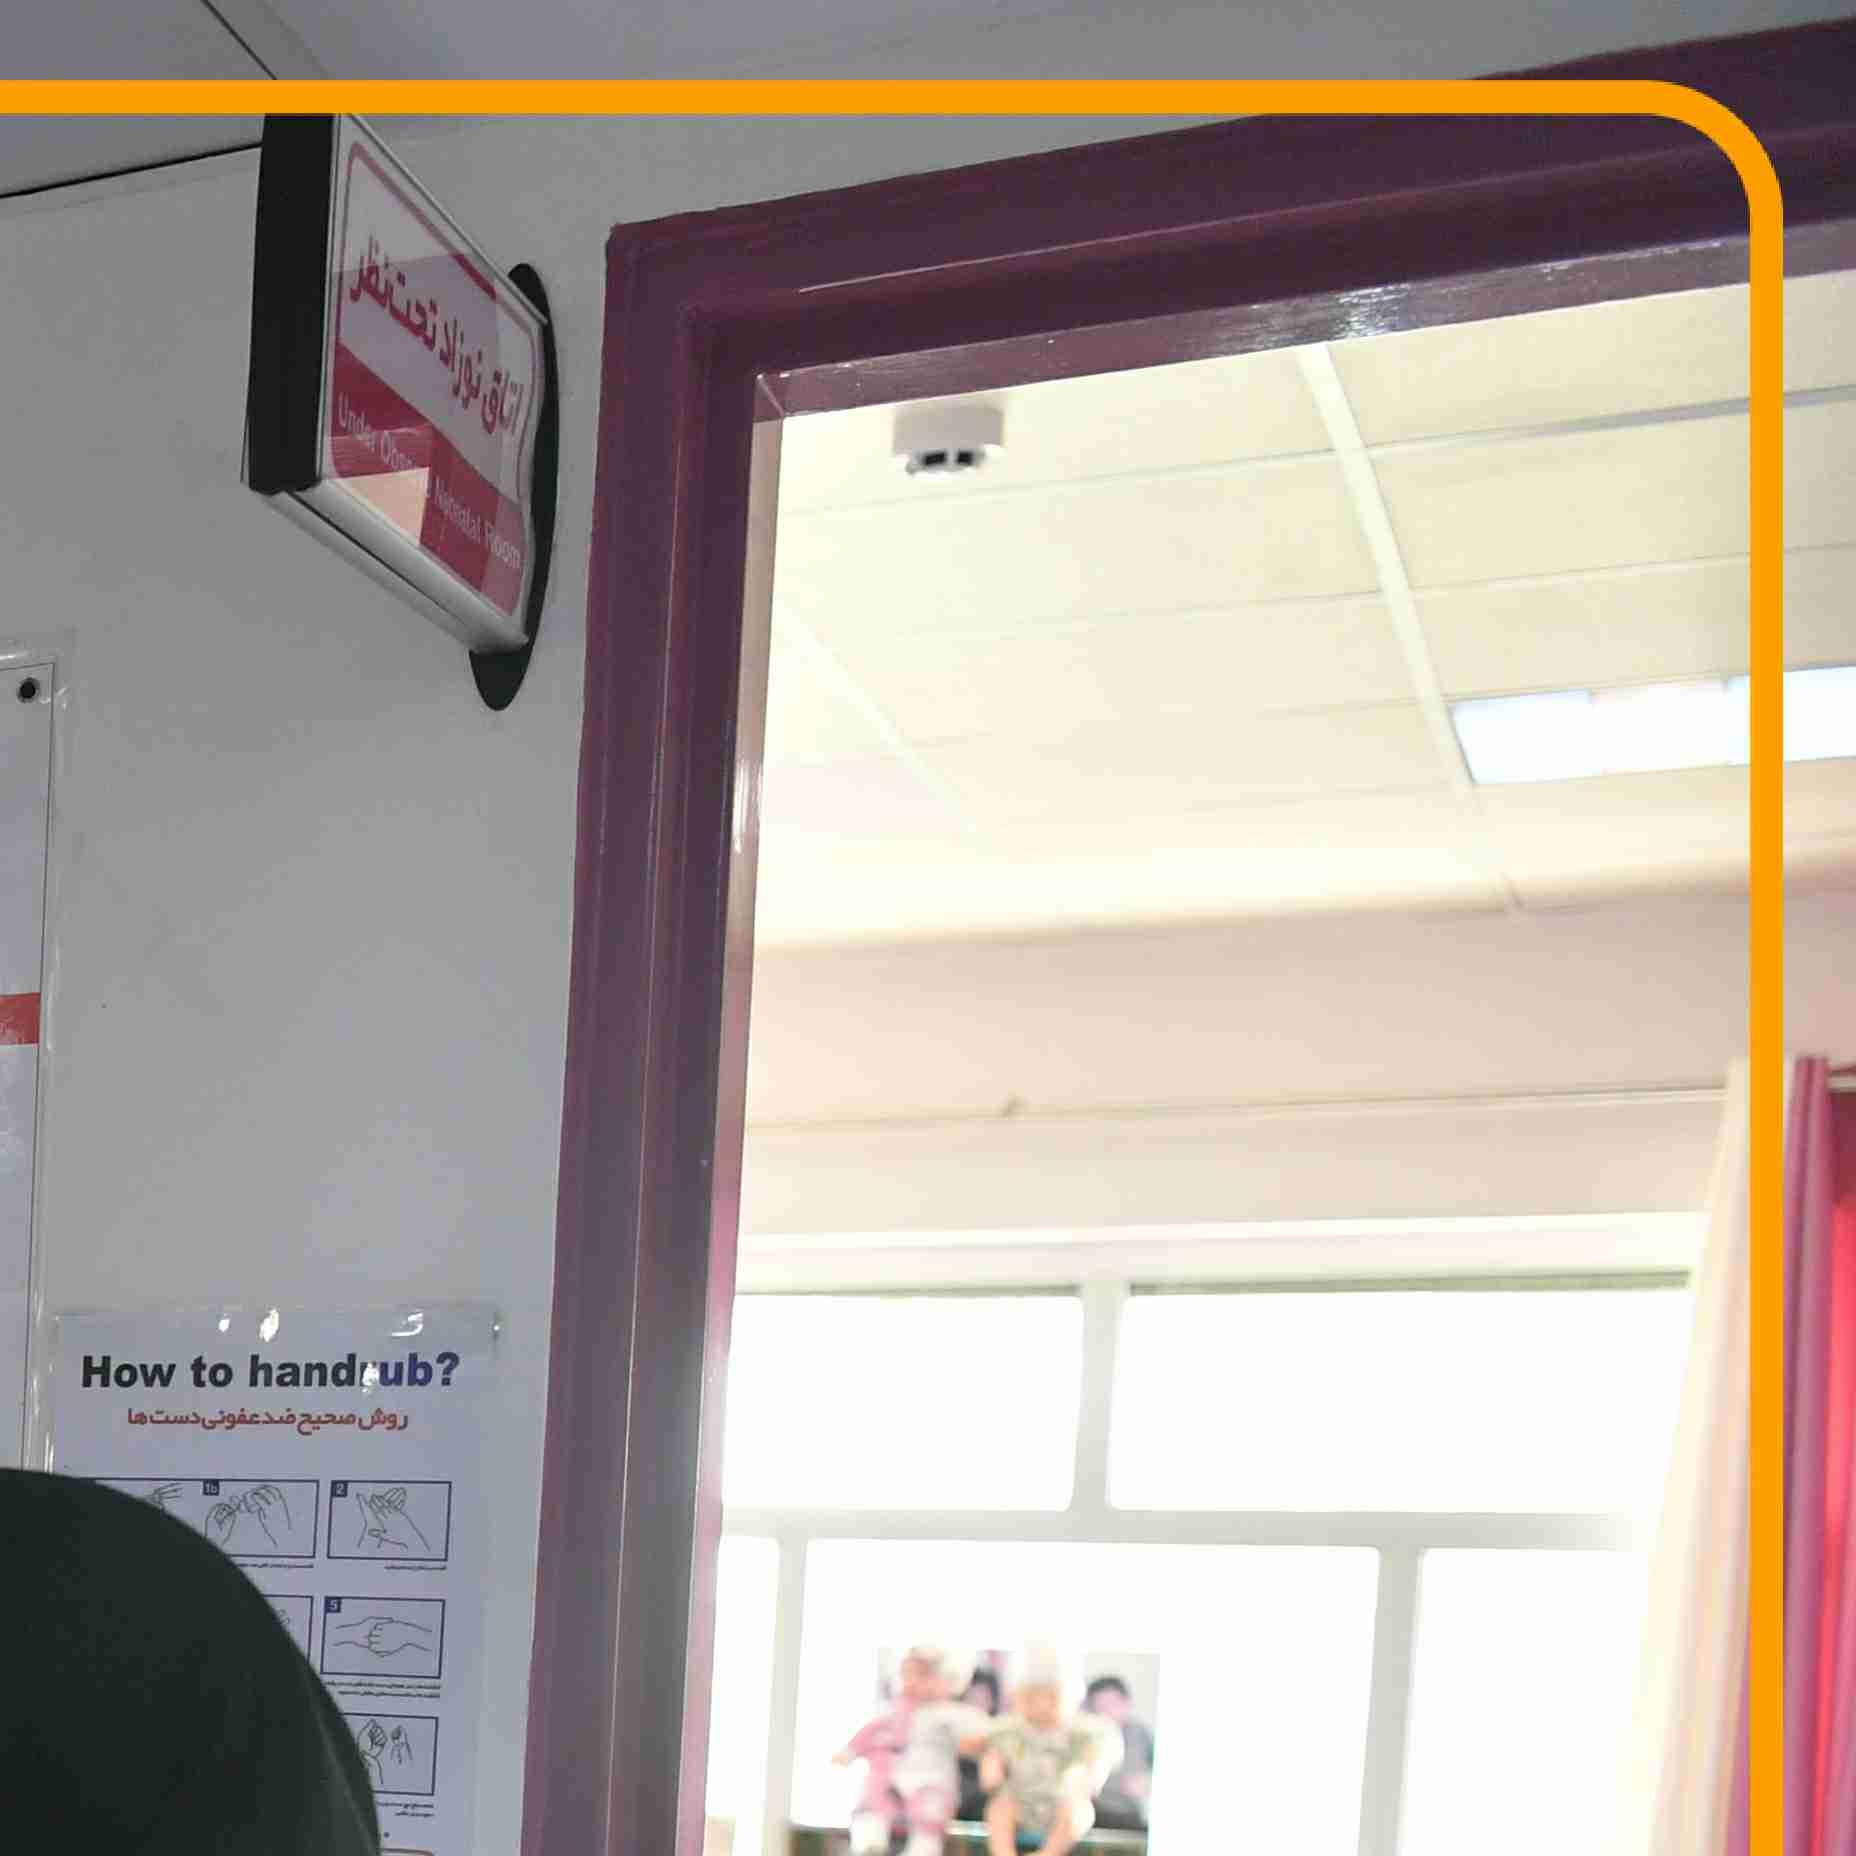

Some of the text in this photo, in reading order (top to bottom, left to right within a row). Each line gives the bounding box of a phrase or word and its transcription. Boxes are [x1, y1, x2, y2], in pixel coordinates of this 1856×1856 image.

[484, 520, 521, 569] Room
[81, 1354, 177, 1389] How
[190, 1355, 234, 1388] to
[296, 1413, 356, 1436] صحیح
[358, 1408, 409, 1432] روش
